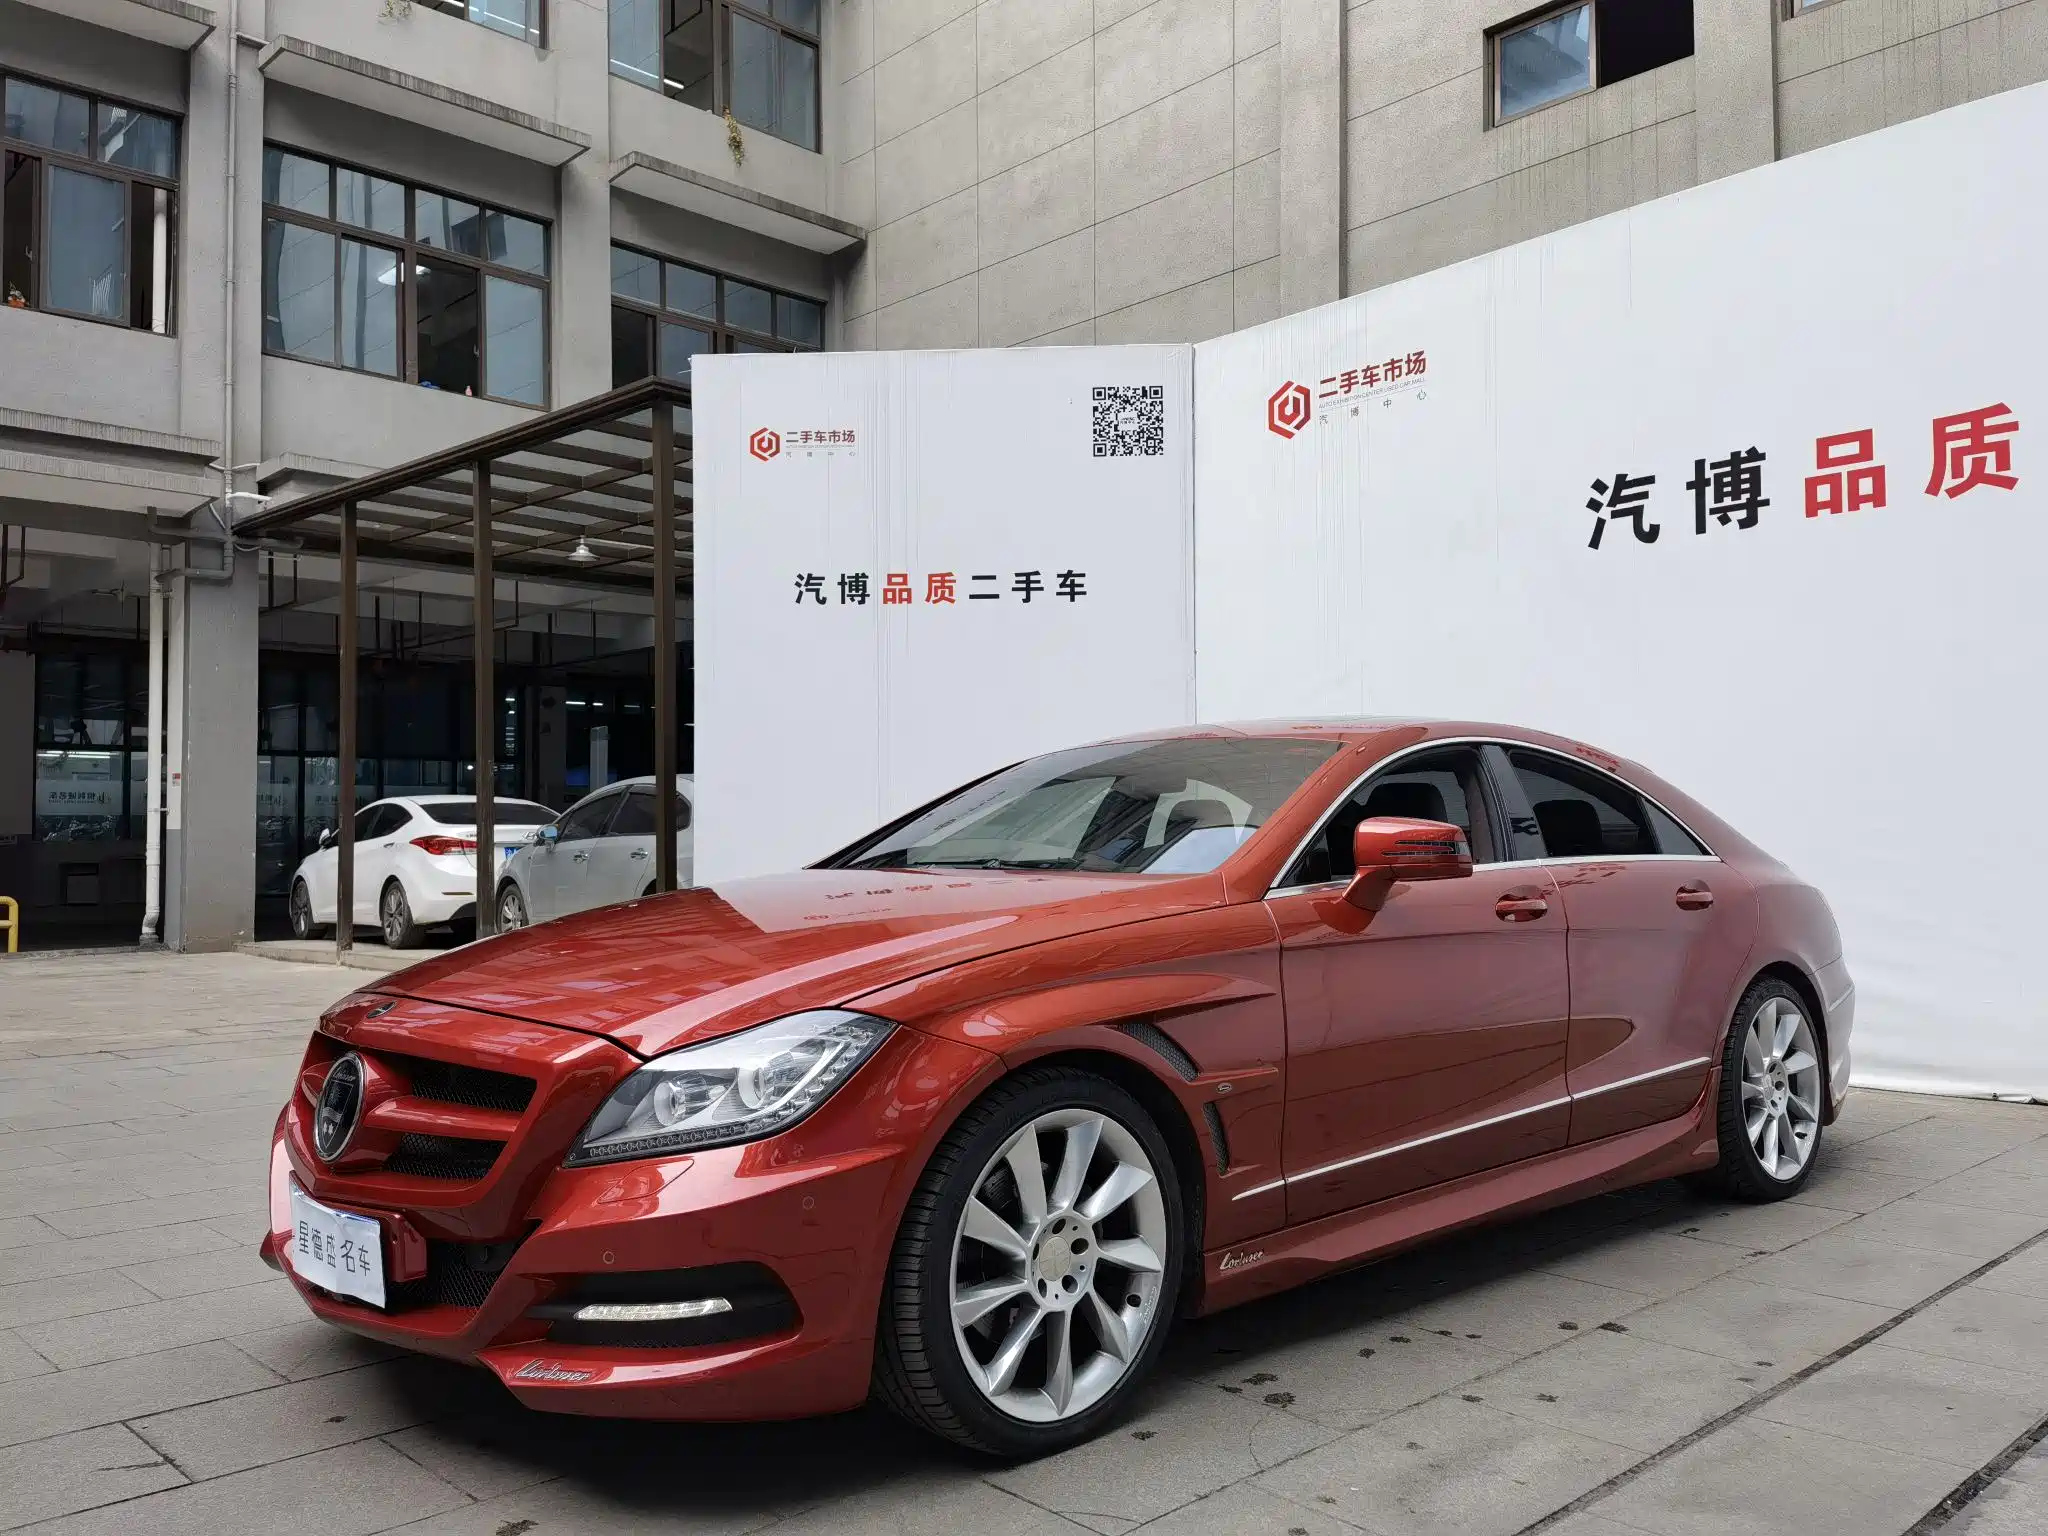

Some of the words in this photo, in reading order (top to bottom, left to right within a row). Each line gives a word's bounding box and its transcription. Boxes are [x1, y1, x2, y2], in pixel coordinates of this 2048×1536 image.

[1318, 350, 1427, 398] 二手车市场
[786, 430, 856, 444] 二手车市场
[1585, 403, 2020, 550] 汽博品质
[794, 569, 1088, 605] 汽博品质二手车
